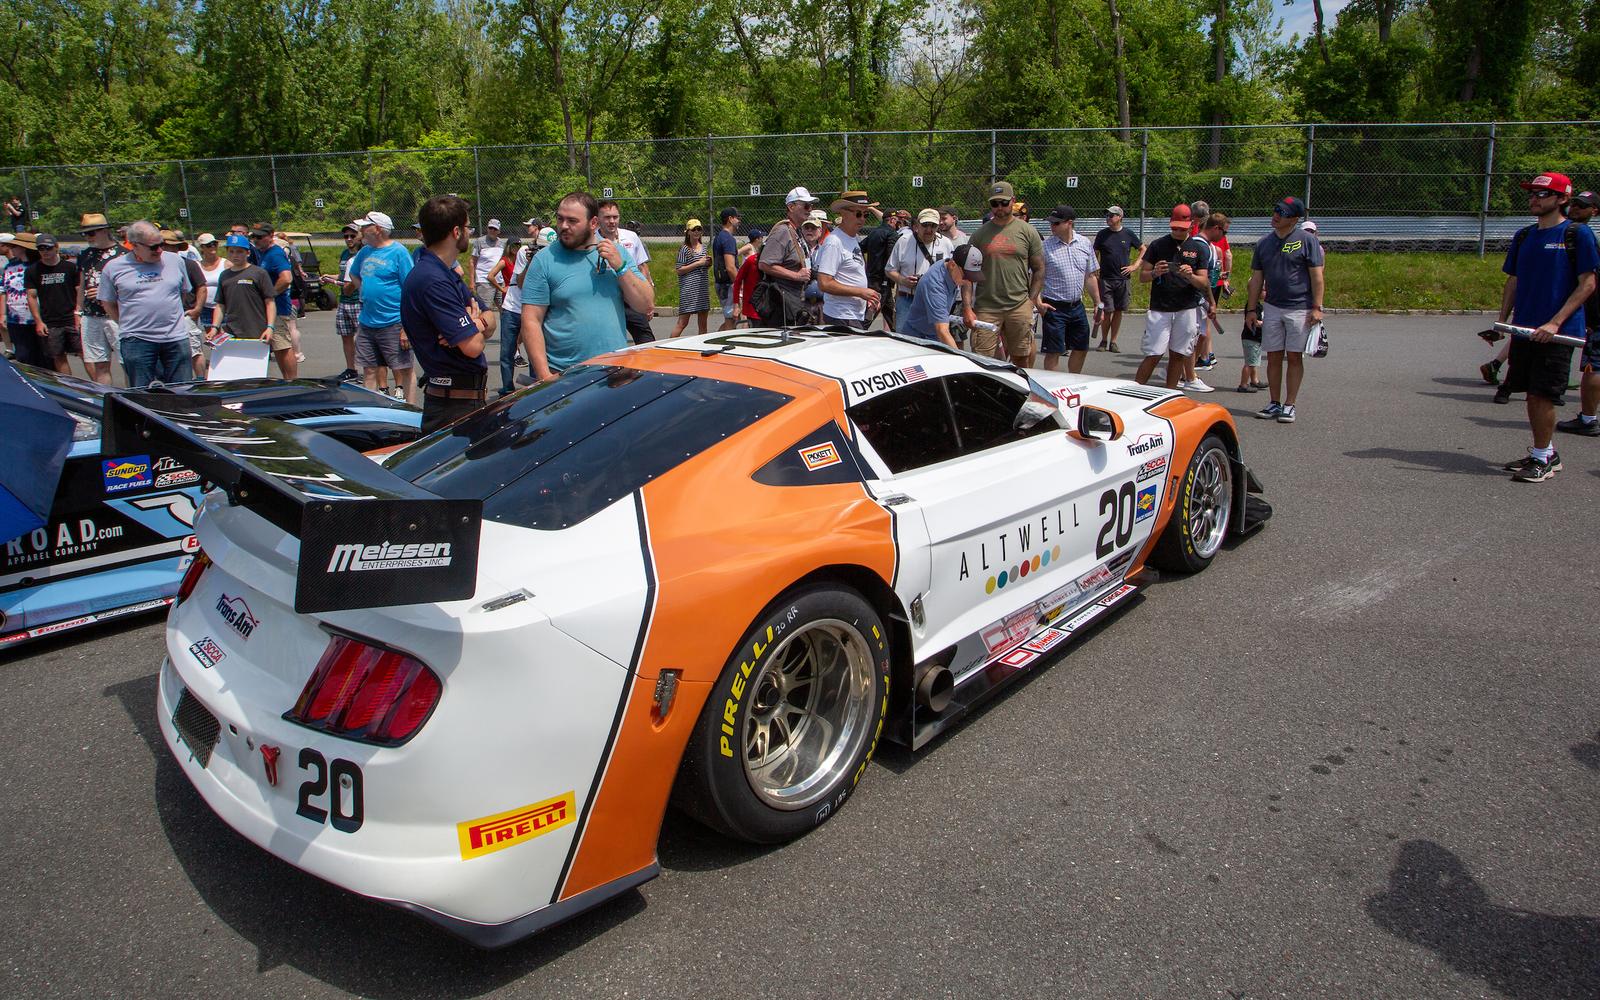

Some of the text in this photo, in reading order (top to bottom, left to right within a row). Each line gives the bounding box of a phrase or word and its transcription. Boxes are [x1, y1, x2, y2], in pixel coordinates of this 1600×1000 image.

[751, 186, 759, 195] 19
[914, 177, 922, 186] 18
[1068, 177, 1077, 187] 17
[1222, 178, 1231, 188] 16
[604, 188, 612, 197] 20
[459, 315, 471, 328] 21
[850, 369, 909, 397] DYSON
[1127, 442, 1150, 457] Trans
[1150, 437, 1164, 450] Am
[106, 463, 147, 478] SUNOCO
[106, 479, 152, 491] RACE FUELS
[1096, 480, 1136, 561] 20
[960, 503, 1080, 582] ALTWELL
[8, 542, 99, 567] APPAREL COMPANY
[327, 541, 451, 573] Meissen
[361, 559, 424, 570] ENTERPRISES
[216, 593, 237, 624] Trans
[233, 611, 254, 638] Am
[775, 606, 800, 635] 20 RR
[203, 642, 223, 662] SCCA
[720, 624, 774, 758] PIRELLI
[296, 747, 364, 834] 20
[469, 800, 567, 850] PIRELLI
